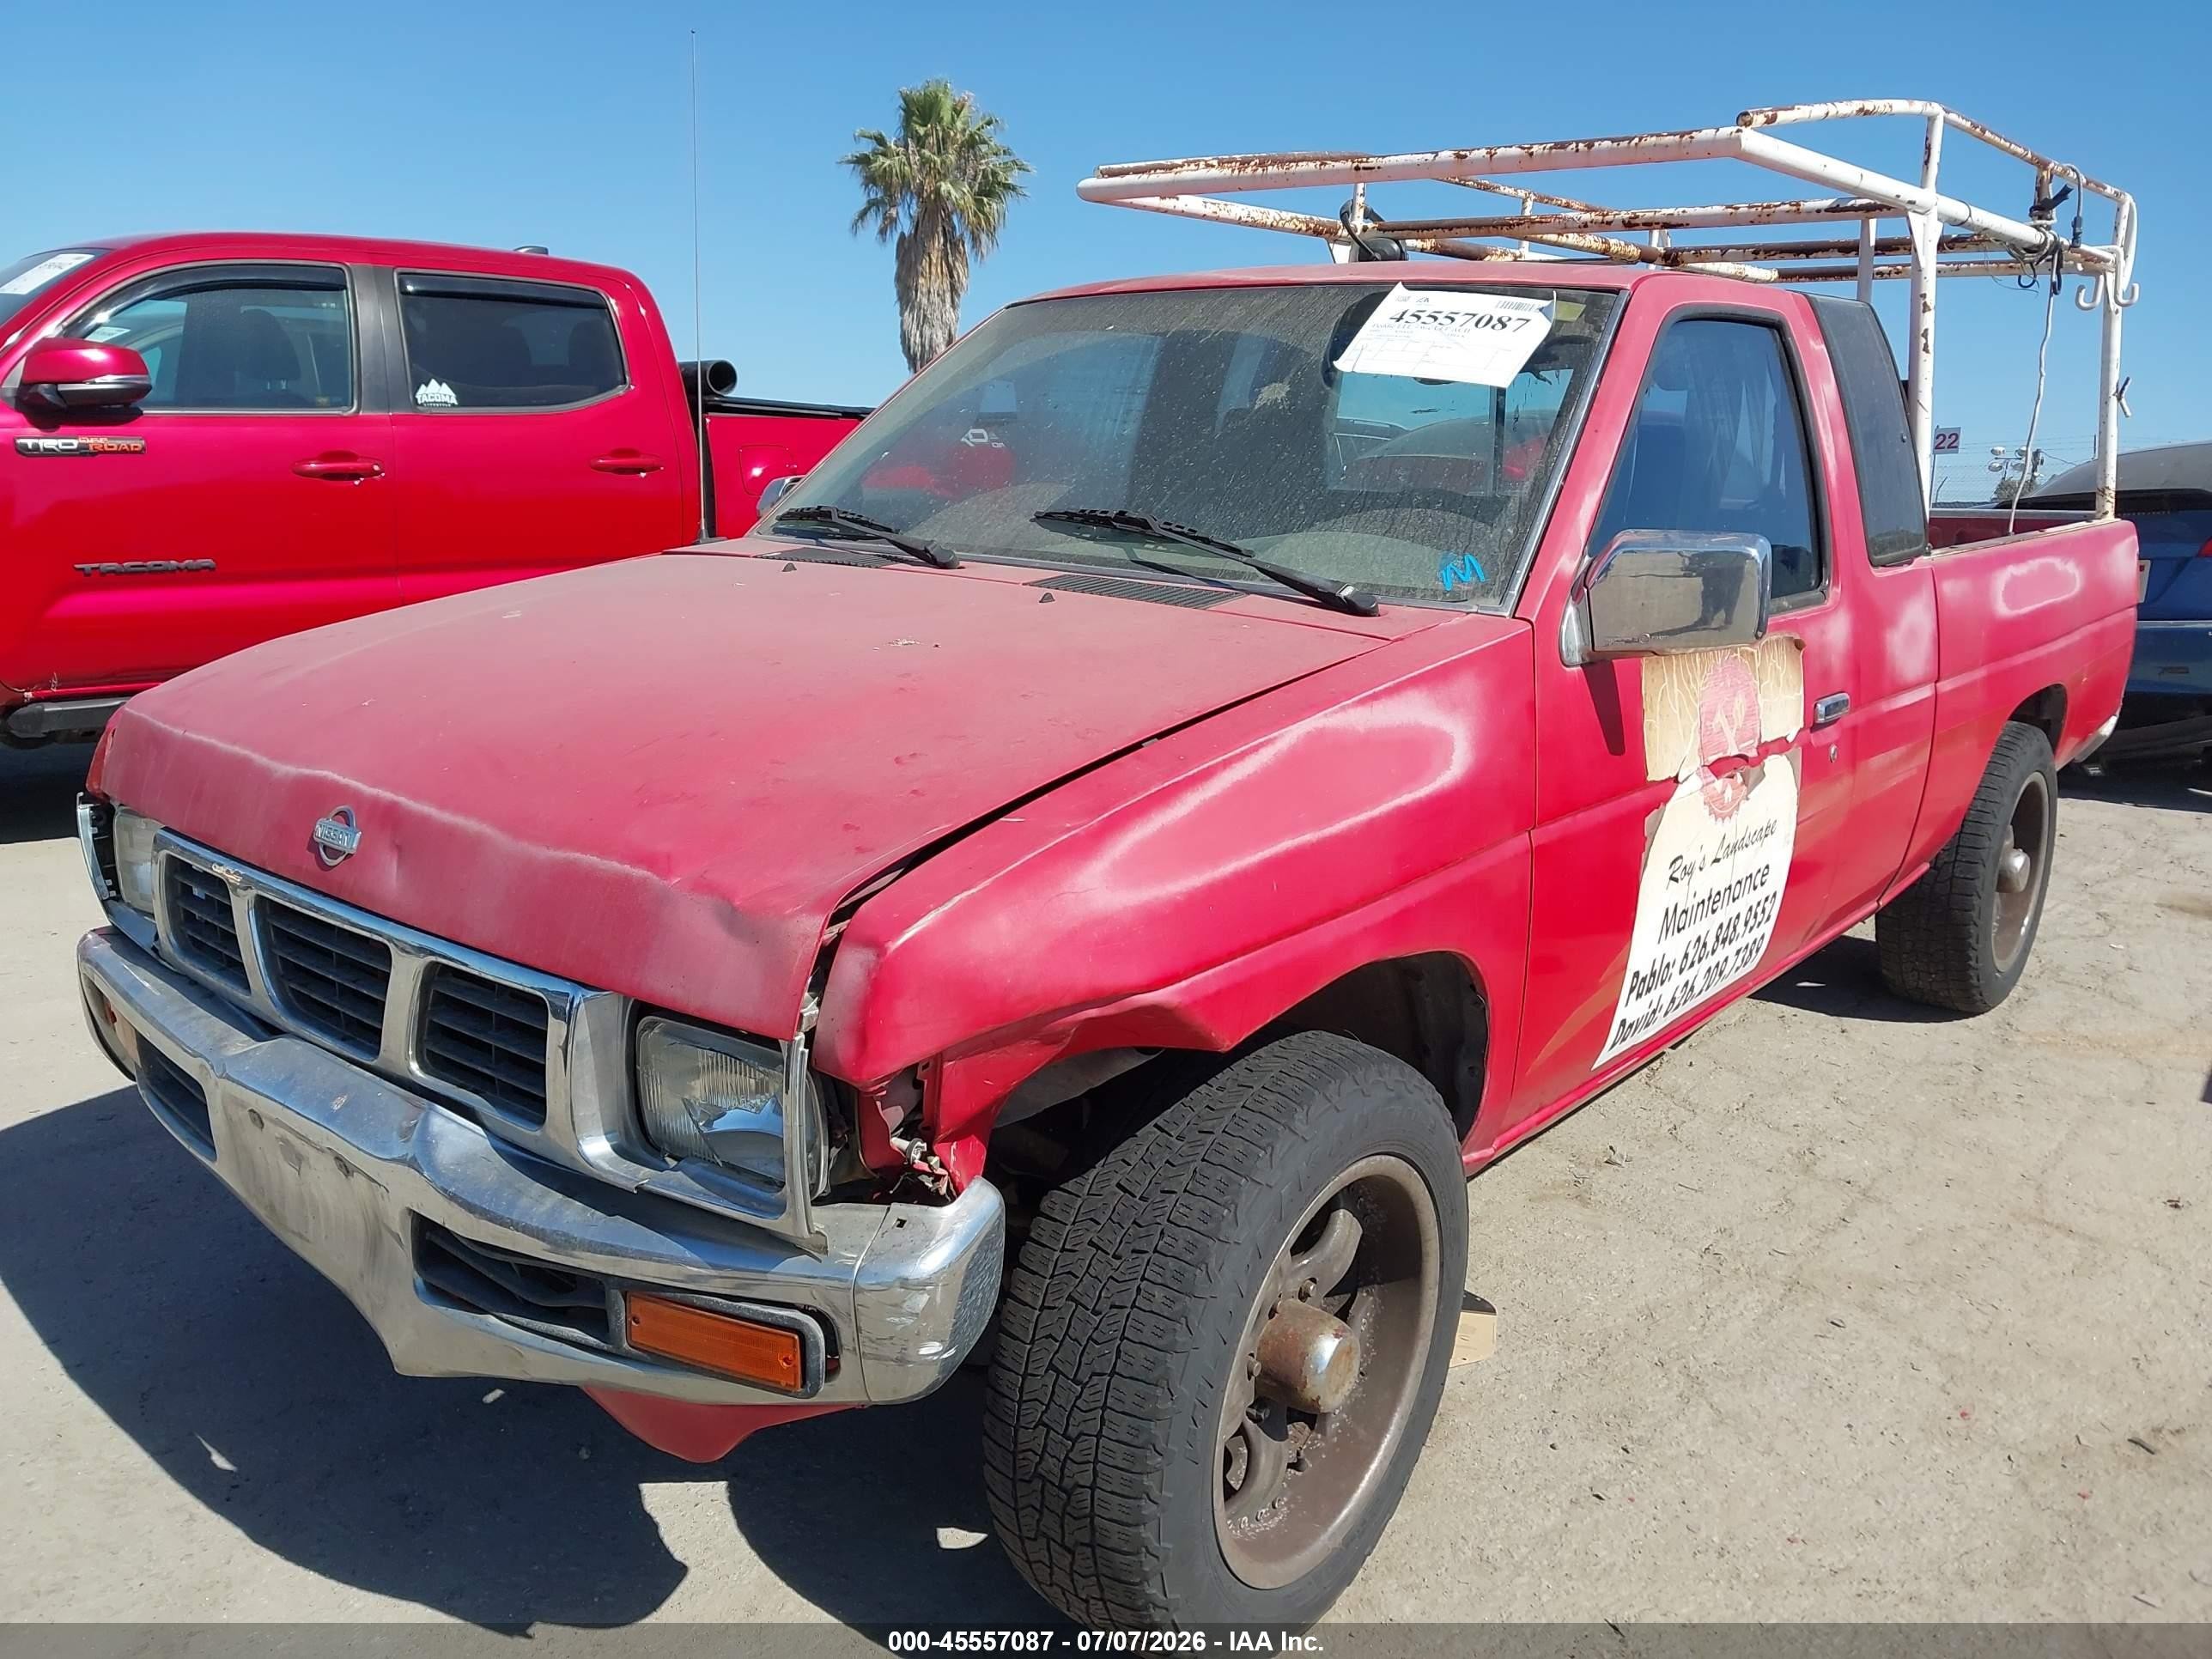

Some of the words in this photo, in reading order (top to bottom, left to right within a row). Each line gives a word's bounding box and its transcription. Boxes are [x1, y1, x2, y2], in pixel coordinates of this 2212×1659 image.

[1389, 308, 1533, 333] 45557087
[415, 392, 459, 405] TACOMA
[16, 438, 79, 453] TRD
[88, 442, 143, 453] ROAD
[1934, 432, 1960, 450] 22
[74, 558, 216, 577] TACOMA
[314, 823, 353, 848] NISSAN
[1666, 843, 1705, 891] Roy's
[1711, 818, 1778, 866] Landscape
[1657, 863, 1770, 945] Maintenance
[1624, 952, 1676, 1008] Pablo:
[1678, 890, 1778, 976] 626.848.9552
[1607, 993, 1663, 1053] David:
